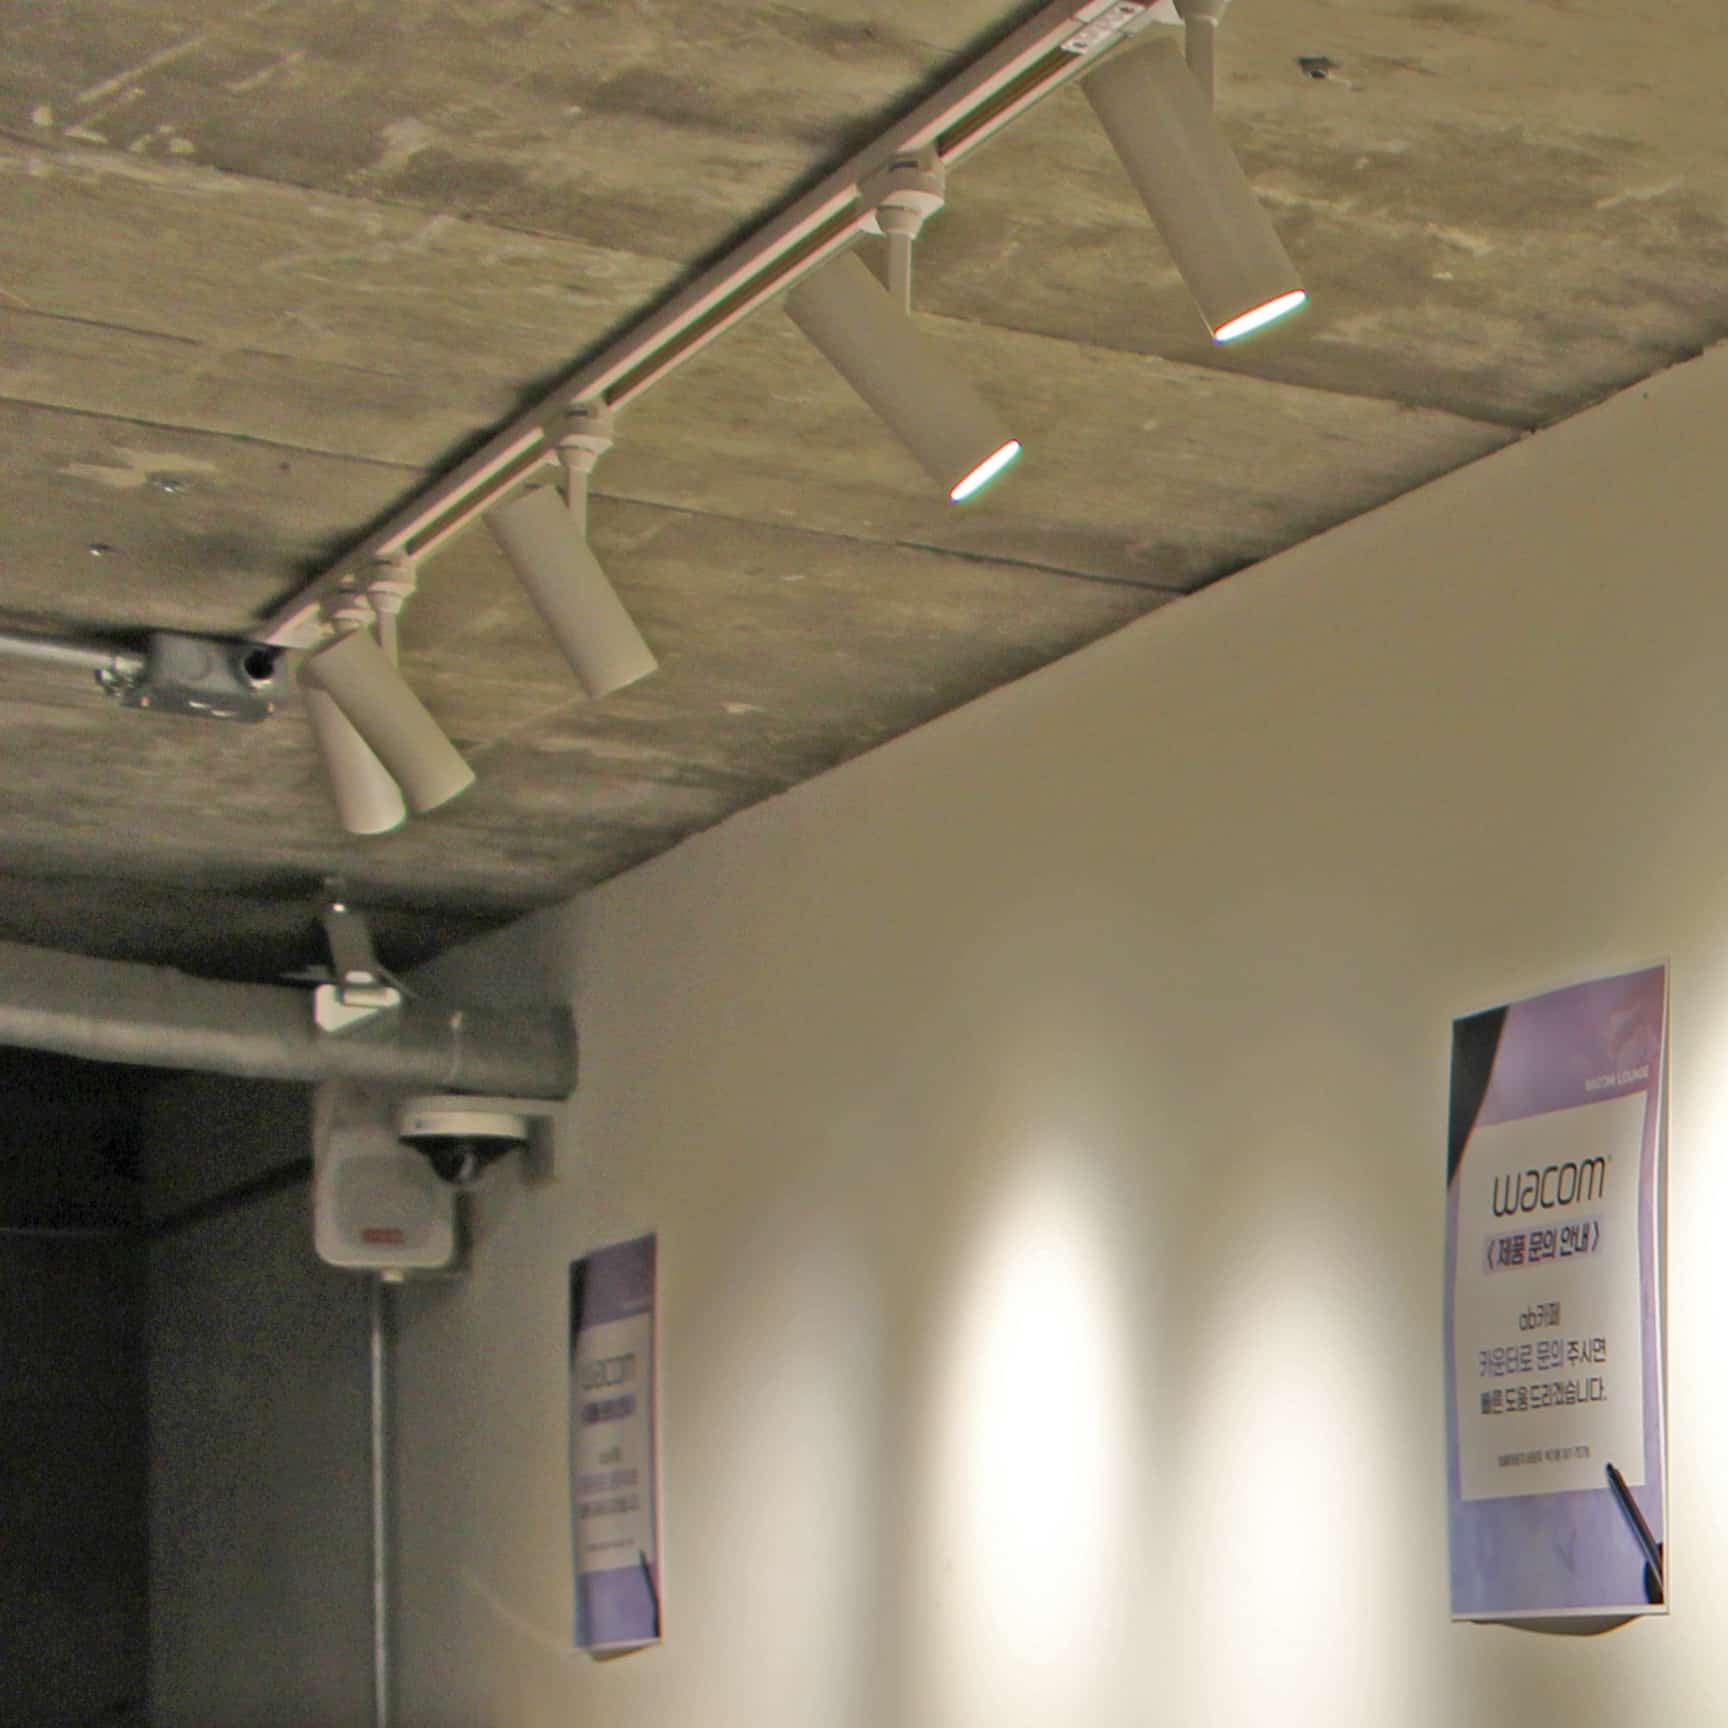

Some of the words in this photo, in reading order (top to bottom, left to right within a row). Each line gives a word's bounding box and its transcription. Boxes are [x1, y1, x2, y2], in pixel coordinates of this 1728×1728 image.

[1492, 1155, 1606, 1217] wacom
[1528, 1228, 1557, 1263] 문의
[1567, 1337, 1607, 1367] 주시면
